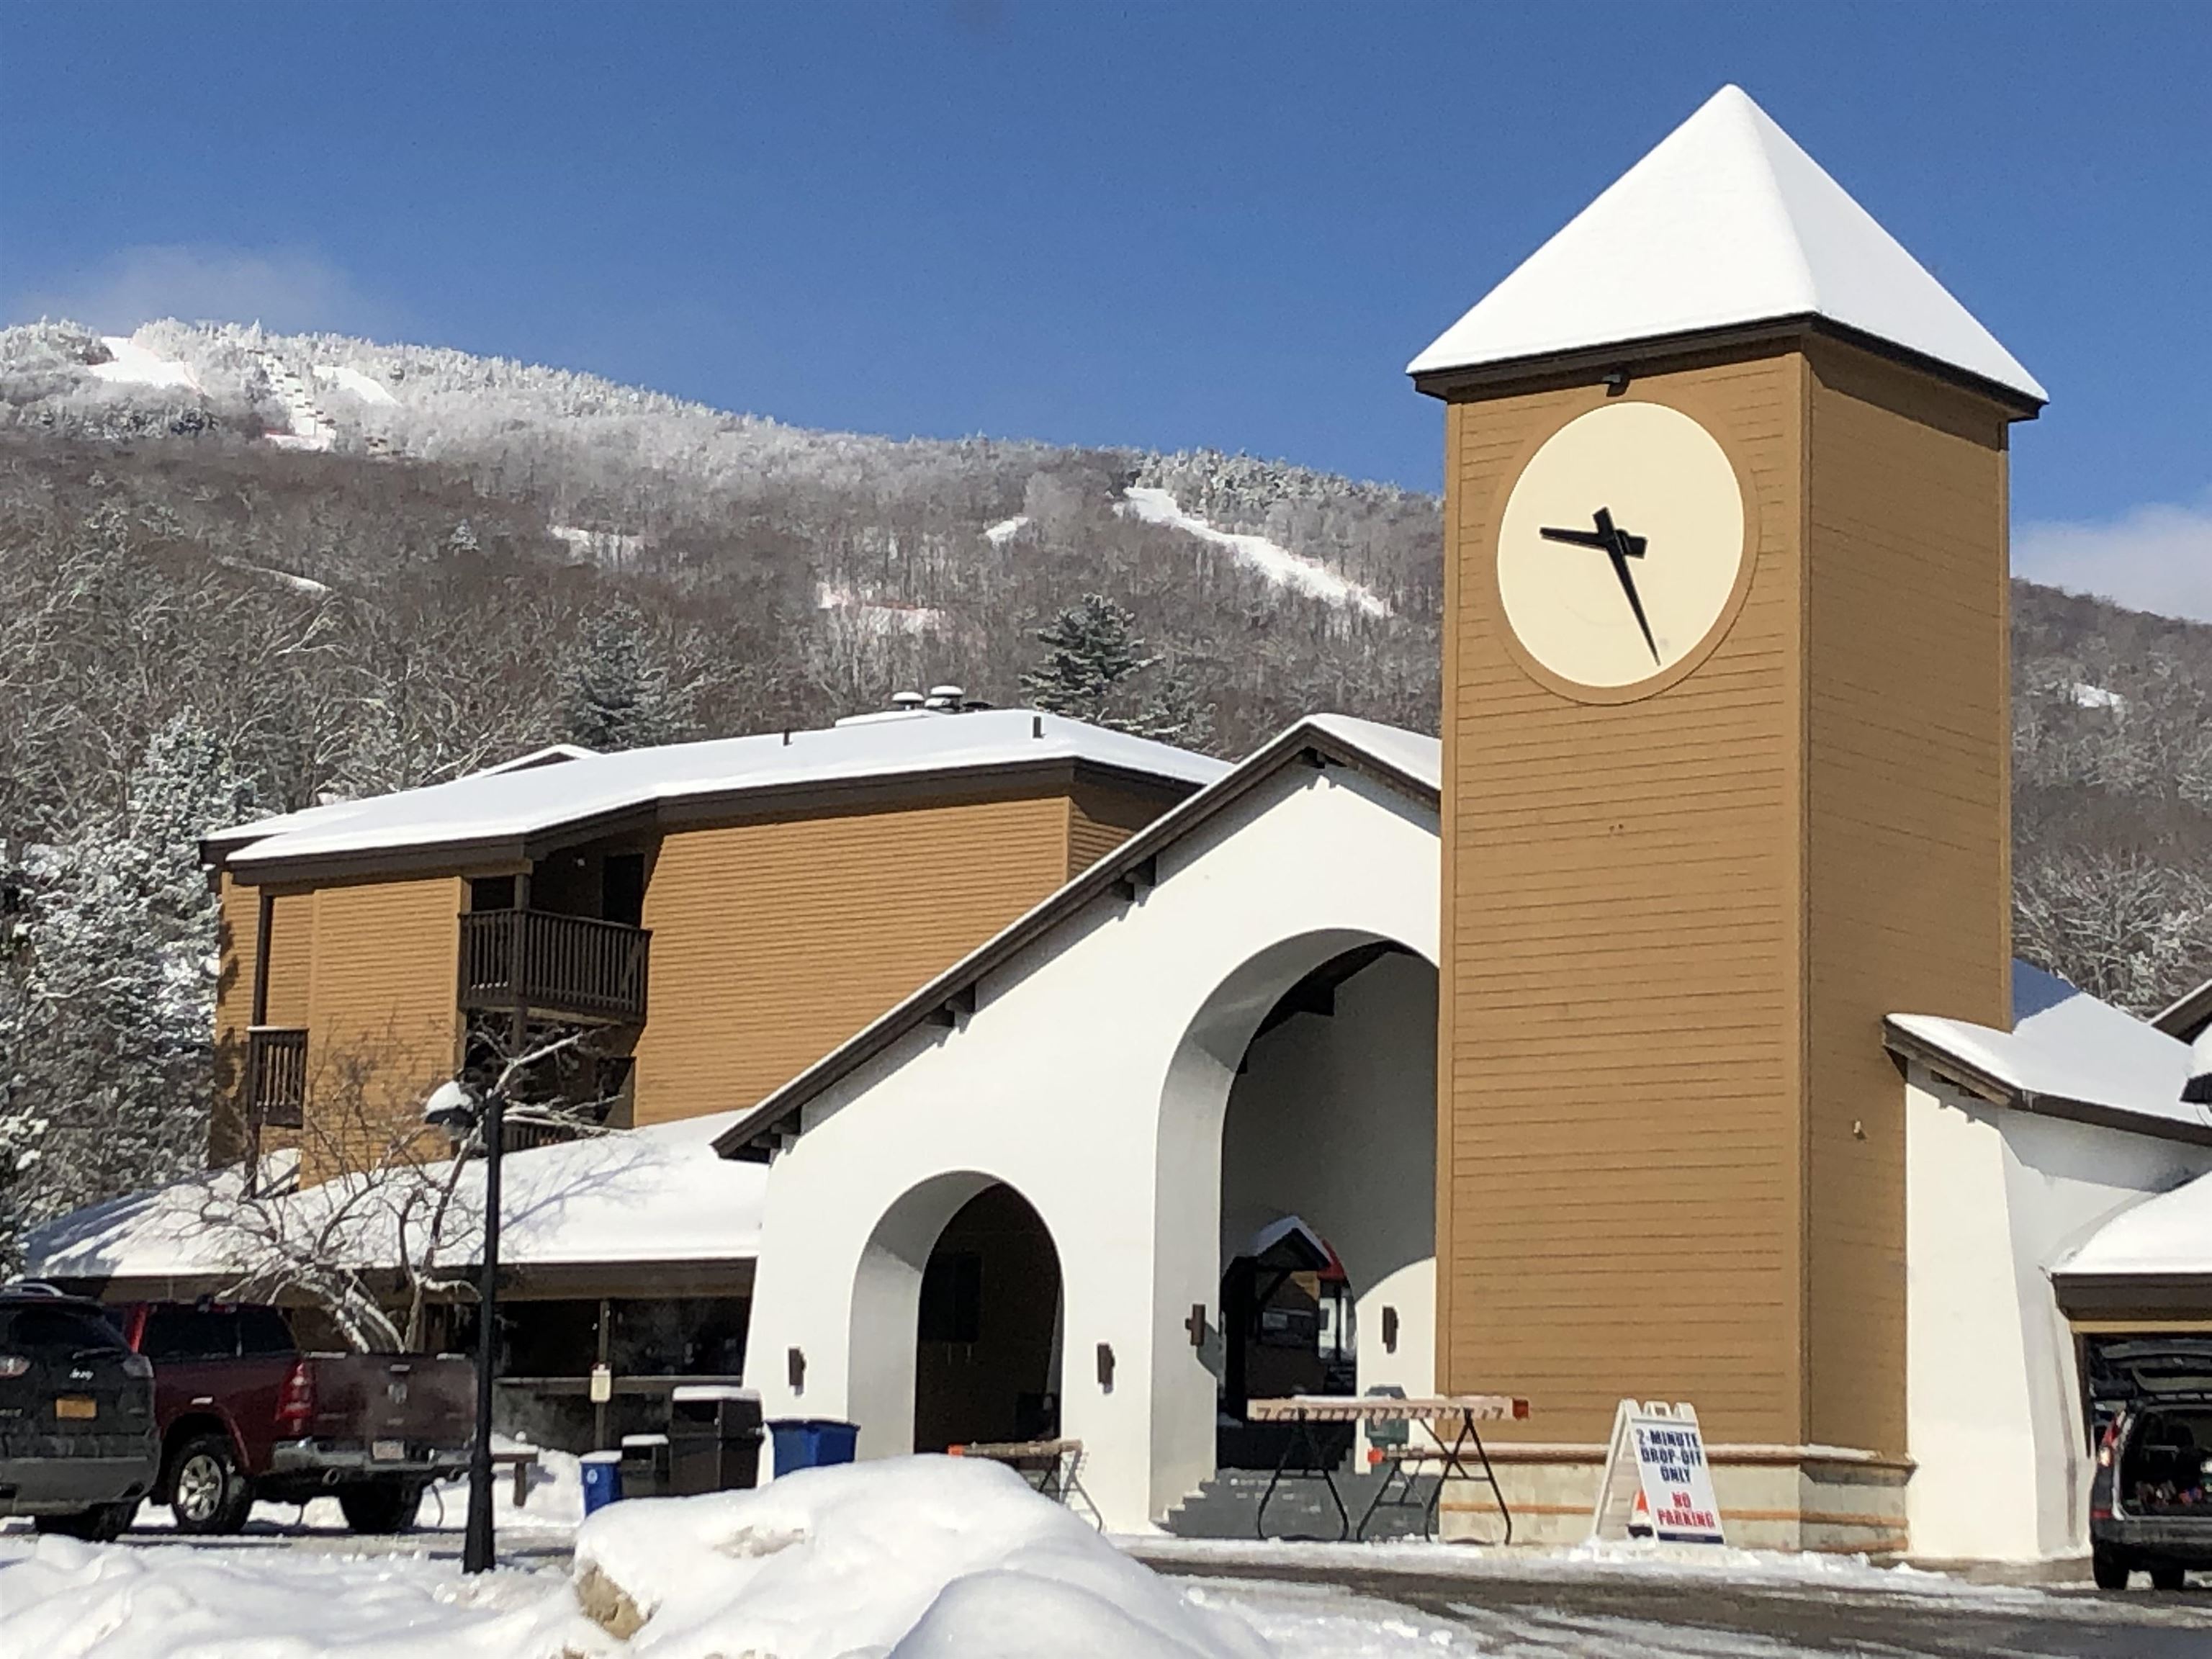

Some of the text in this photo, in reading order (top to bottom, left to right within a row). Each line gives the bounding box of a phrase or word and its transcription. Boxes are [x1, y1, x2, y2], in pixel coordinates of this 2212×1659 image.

[1660, 1466, 1691, 1483] ONLY
[1671, 1491, 1691, 1508] NO
[1657, 1509, 1715, 1528] PARKING
